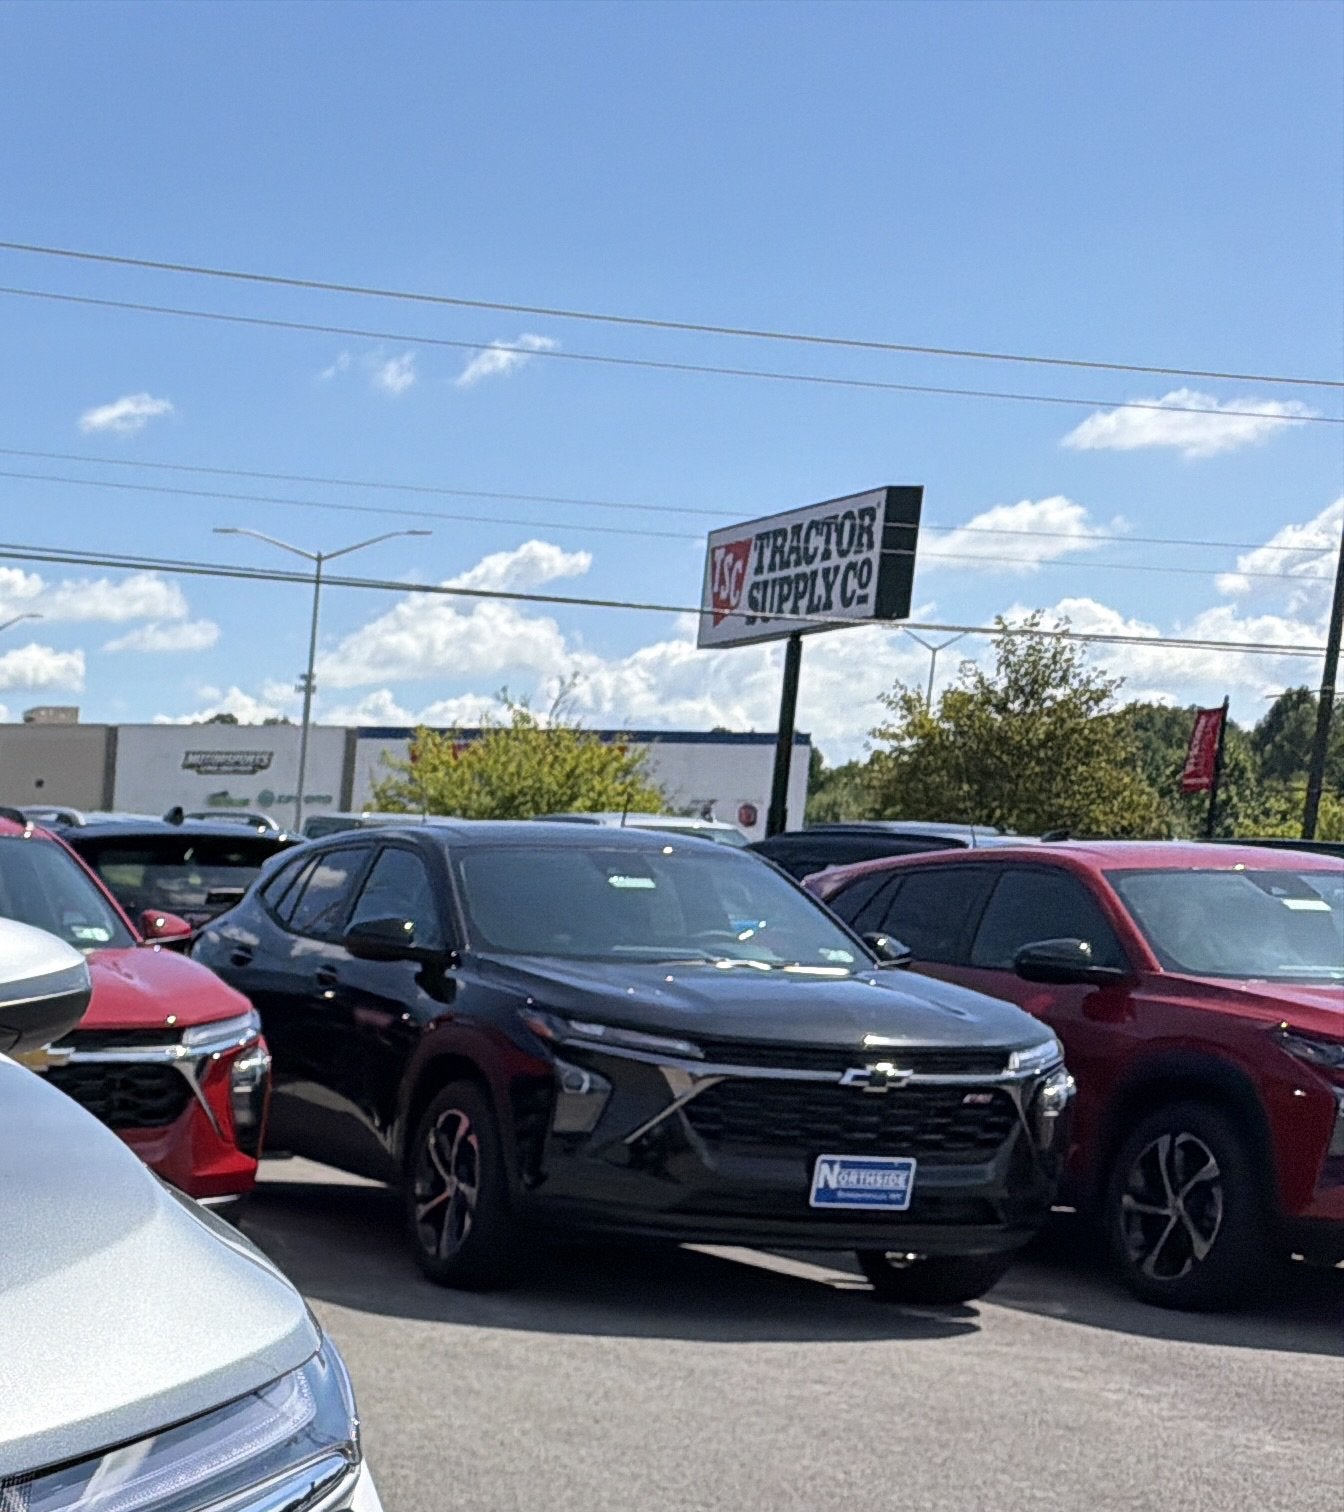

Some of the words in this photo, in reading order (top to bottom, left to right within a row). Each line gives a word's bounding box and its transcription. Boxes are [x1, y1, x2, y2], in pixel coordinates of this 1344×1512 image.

[753, 506, 877, 575] TRACTOR
[713, 547, 743, 607] TSC
[745, 565, 839, 626] SUPPLY
[817, 1162, 909, 1189] NORTHSIDE
